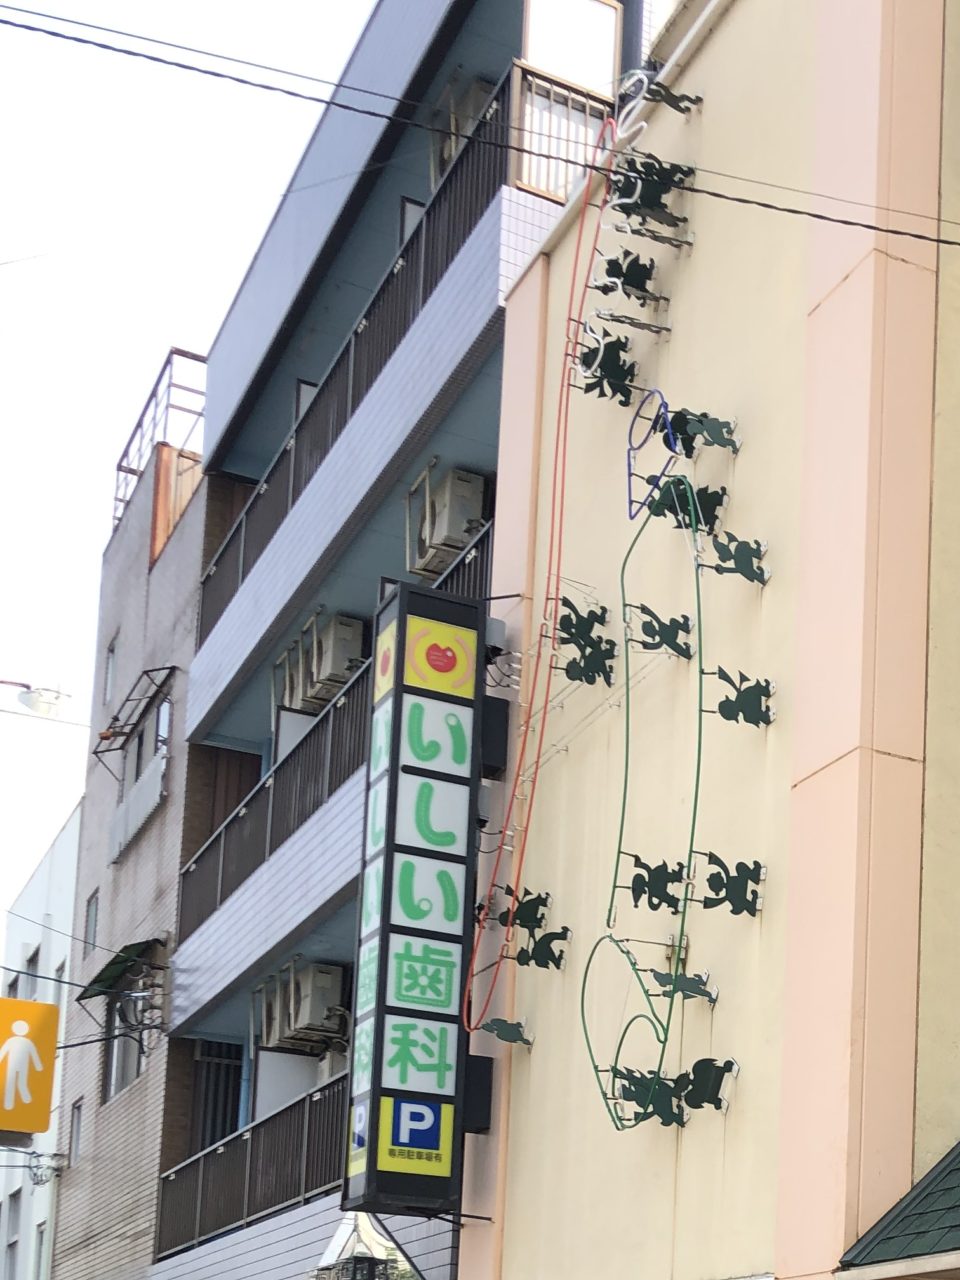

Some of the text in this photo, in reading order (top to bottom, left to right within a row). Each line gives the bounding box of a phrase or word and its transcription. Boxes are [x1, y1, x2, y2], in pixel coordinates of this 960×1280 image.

[388, 702, 468, 1089] いしい歯科
[398, 1101, 435, 1144] P
